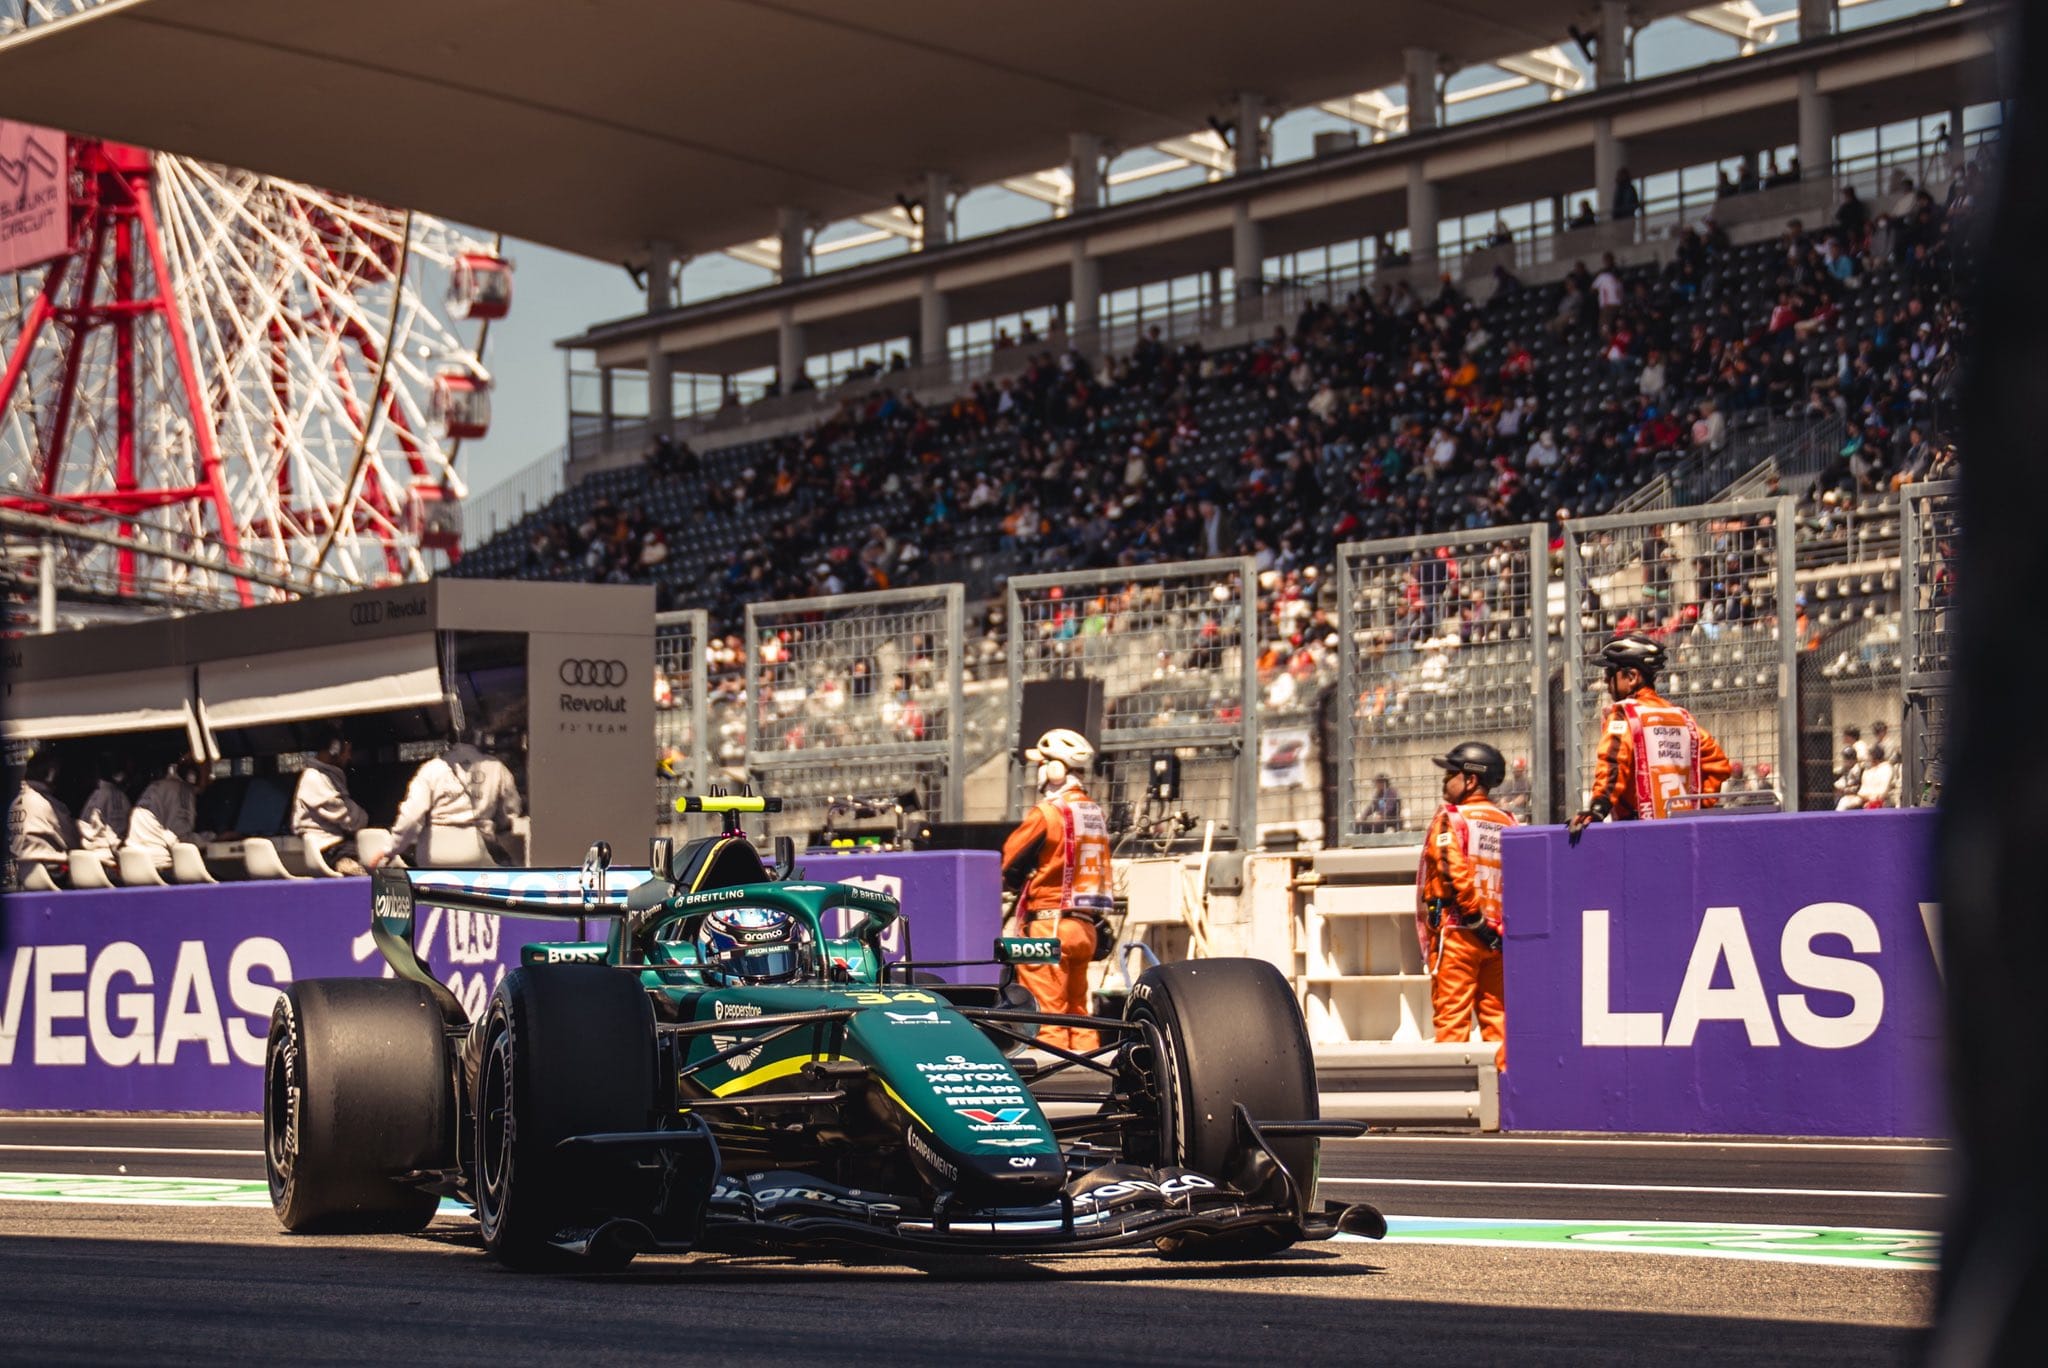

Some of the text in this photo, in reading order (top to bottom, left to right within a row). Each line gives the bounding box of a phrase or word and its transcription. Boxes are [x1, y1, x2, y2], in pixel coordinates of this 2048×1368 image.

[387, 597, 427, 619] Revolut
[560, 693, 627, 713] Revolut
[375, 887, 411, 919] coinbase
[686, 889, 745, 905] BREITLING
[859, 890, 897, 904] BREITLING
[744, 929, 783, 941] aramco
[548, 947, 600, 964] BOSS
[747, 947, 768, 955] ASTON
[1010, 942, 1052, 958] BOSS
[1581, 901, 1886, 1049] LAS
[844, 991, 937, 1005] 34
[724, 1002, 762, 1019] pepperstone
[916, 1062, 1006, 1072] NexGen
[925, 1072, 1014, 1083] xerox
[932, 1084, 1022, 1095] NetApp
[967, 1124, 1037, 1132] Valvoline
[1072, 1174, 1216, 1207] ramco
